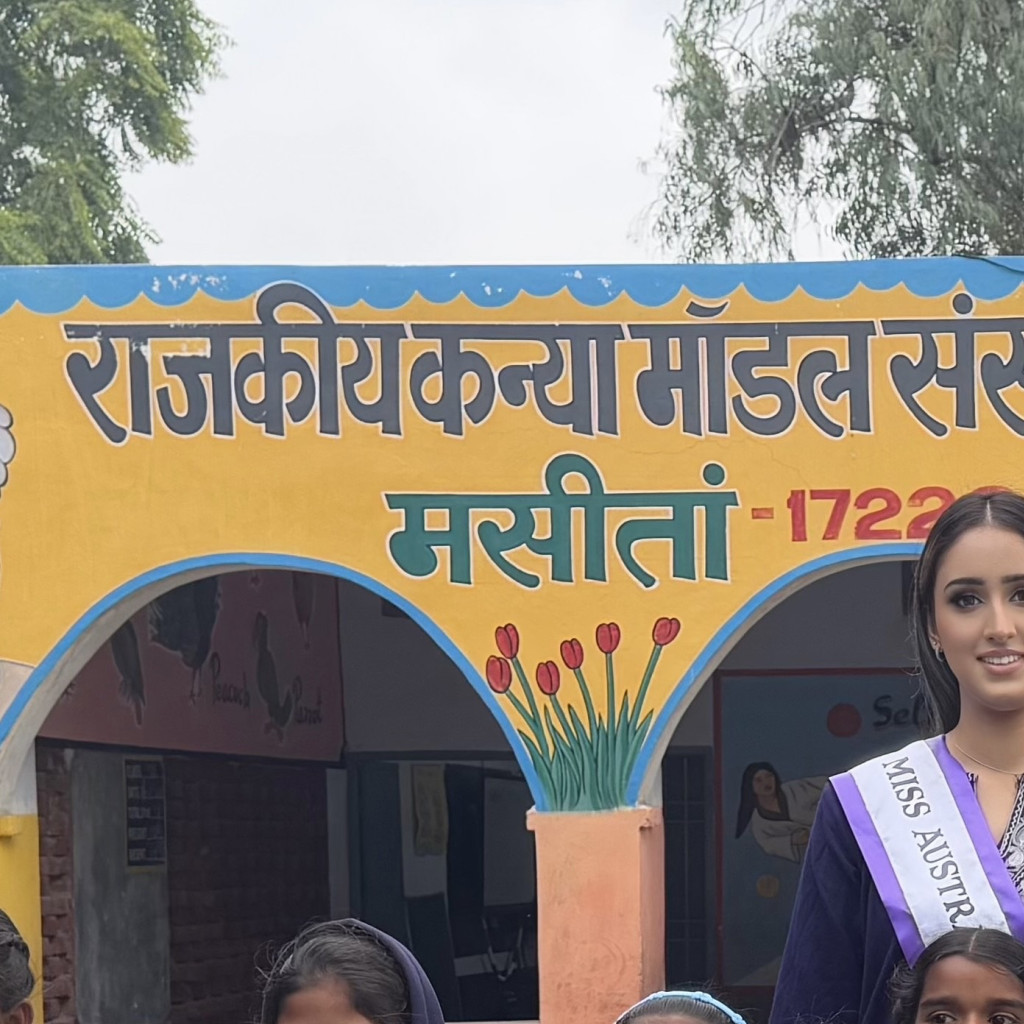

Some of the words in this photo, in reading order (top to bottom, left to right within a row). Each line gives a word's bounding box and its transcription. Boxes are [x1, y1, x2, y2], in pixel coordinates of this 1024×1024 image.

[63, 281, 408, 445] राजकीय
[410, 322, 625, 438] कन्या
[383, 452, 739, 588] मसीतां
[872, 694, 920, 728] Sel
[881, 755, 932, 821] MISS
[911, 826, 977, 925] AUSTR
